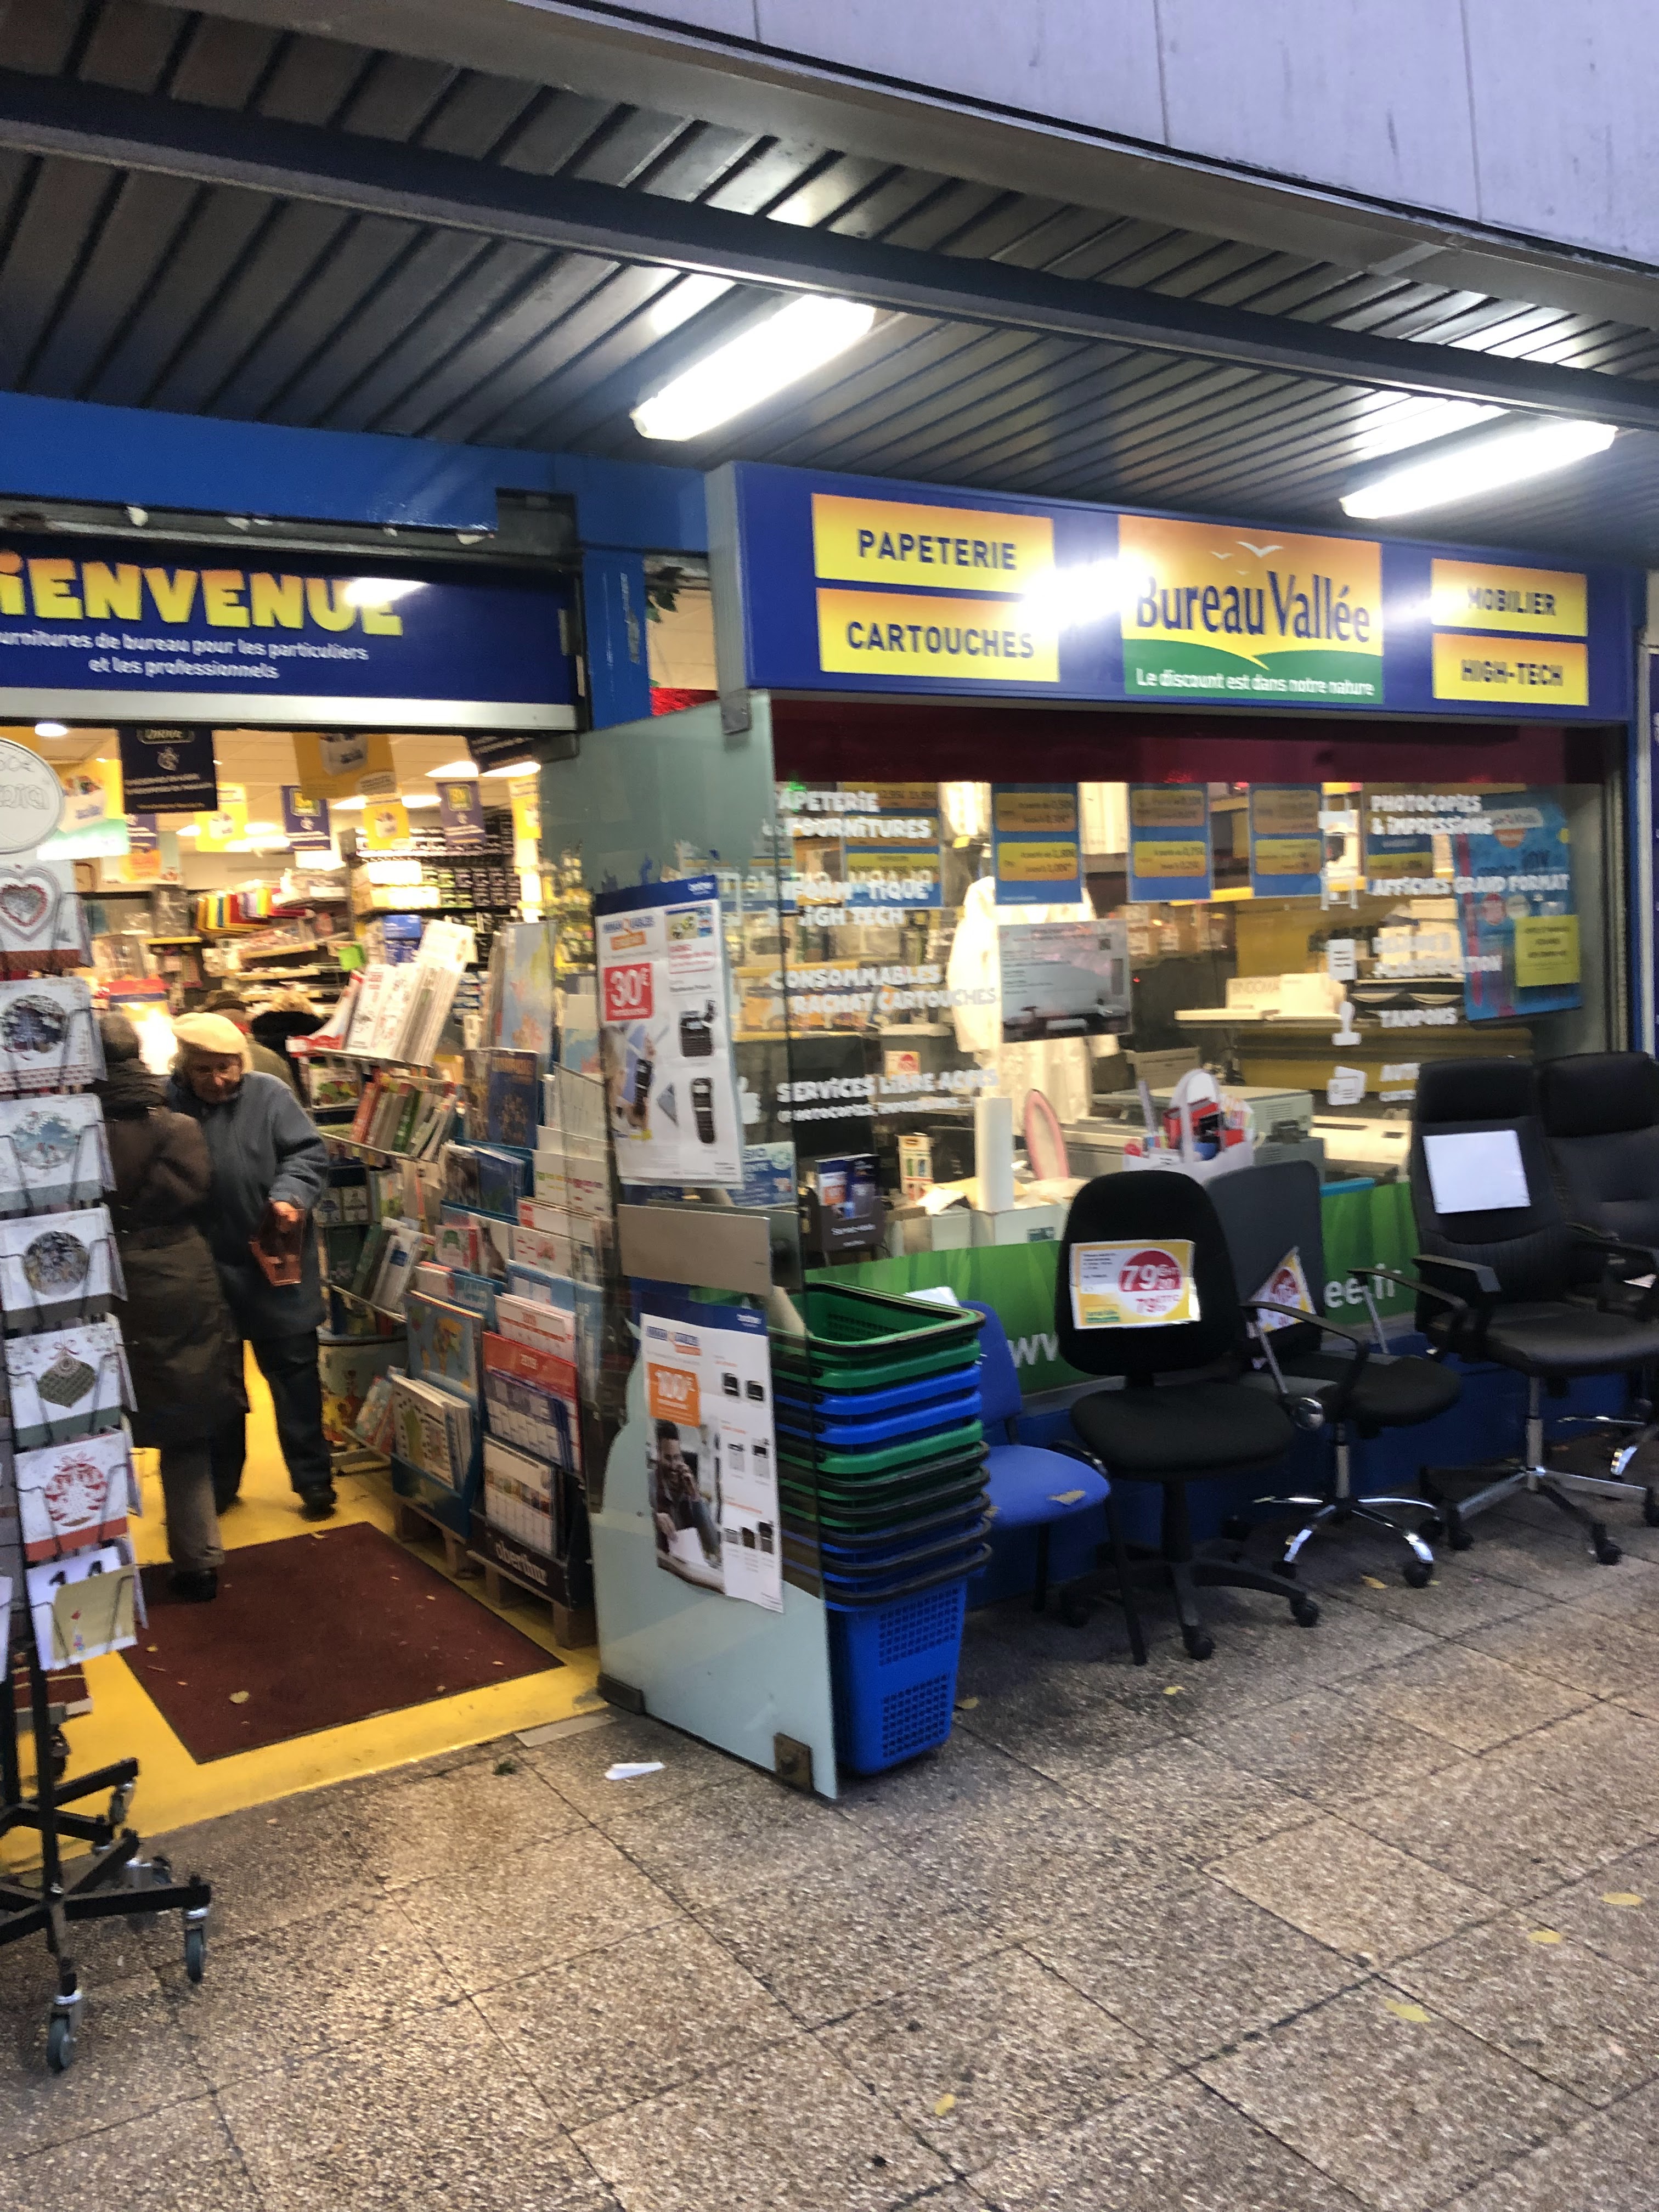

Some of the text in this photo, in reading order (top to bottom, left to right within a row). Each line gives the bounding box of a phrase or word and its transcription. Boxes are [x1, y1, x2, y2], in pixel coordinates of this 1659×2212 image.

[857, 529, 1017, 570] PAPETERIE
[1136, 570, 1370, 642] Bureau Vallée
[1468, 586, 1556, 616] MOBILIER
[94, 632, 121, 650] de
[122, 633, 190, 652] bureau
[191, 639, 237, 656] pour
[238, 638, 267, 656] les
[268, 641, 369, 660] particuliers
[846, 622, 1035, 658] CARTOUCHES
[88, 656, 280, 679] et les professionnels
[1460, 659, 1563, 687] HIGH-TECH
[1136, 668, 1375, 696] Le discount est dans notre nature
[775, 791, 880, 812] APETERIE
